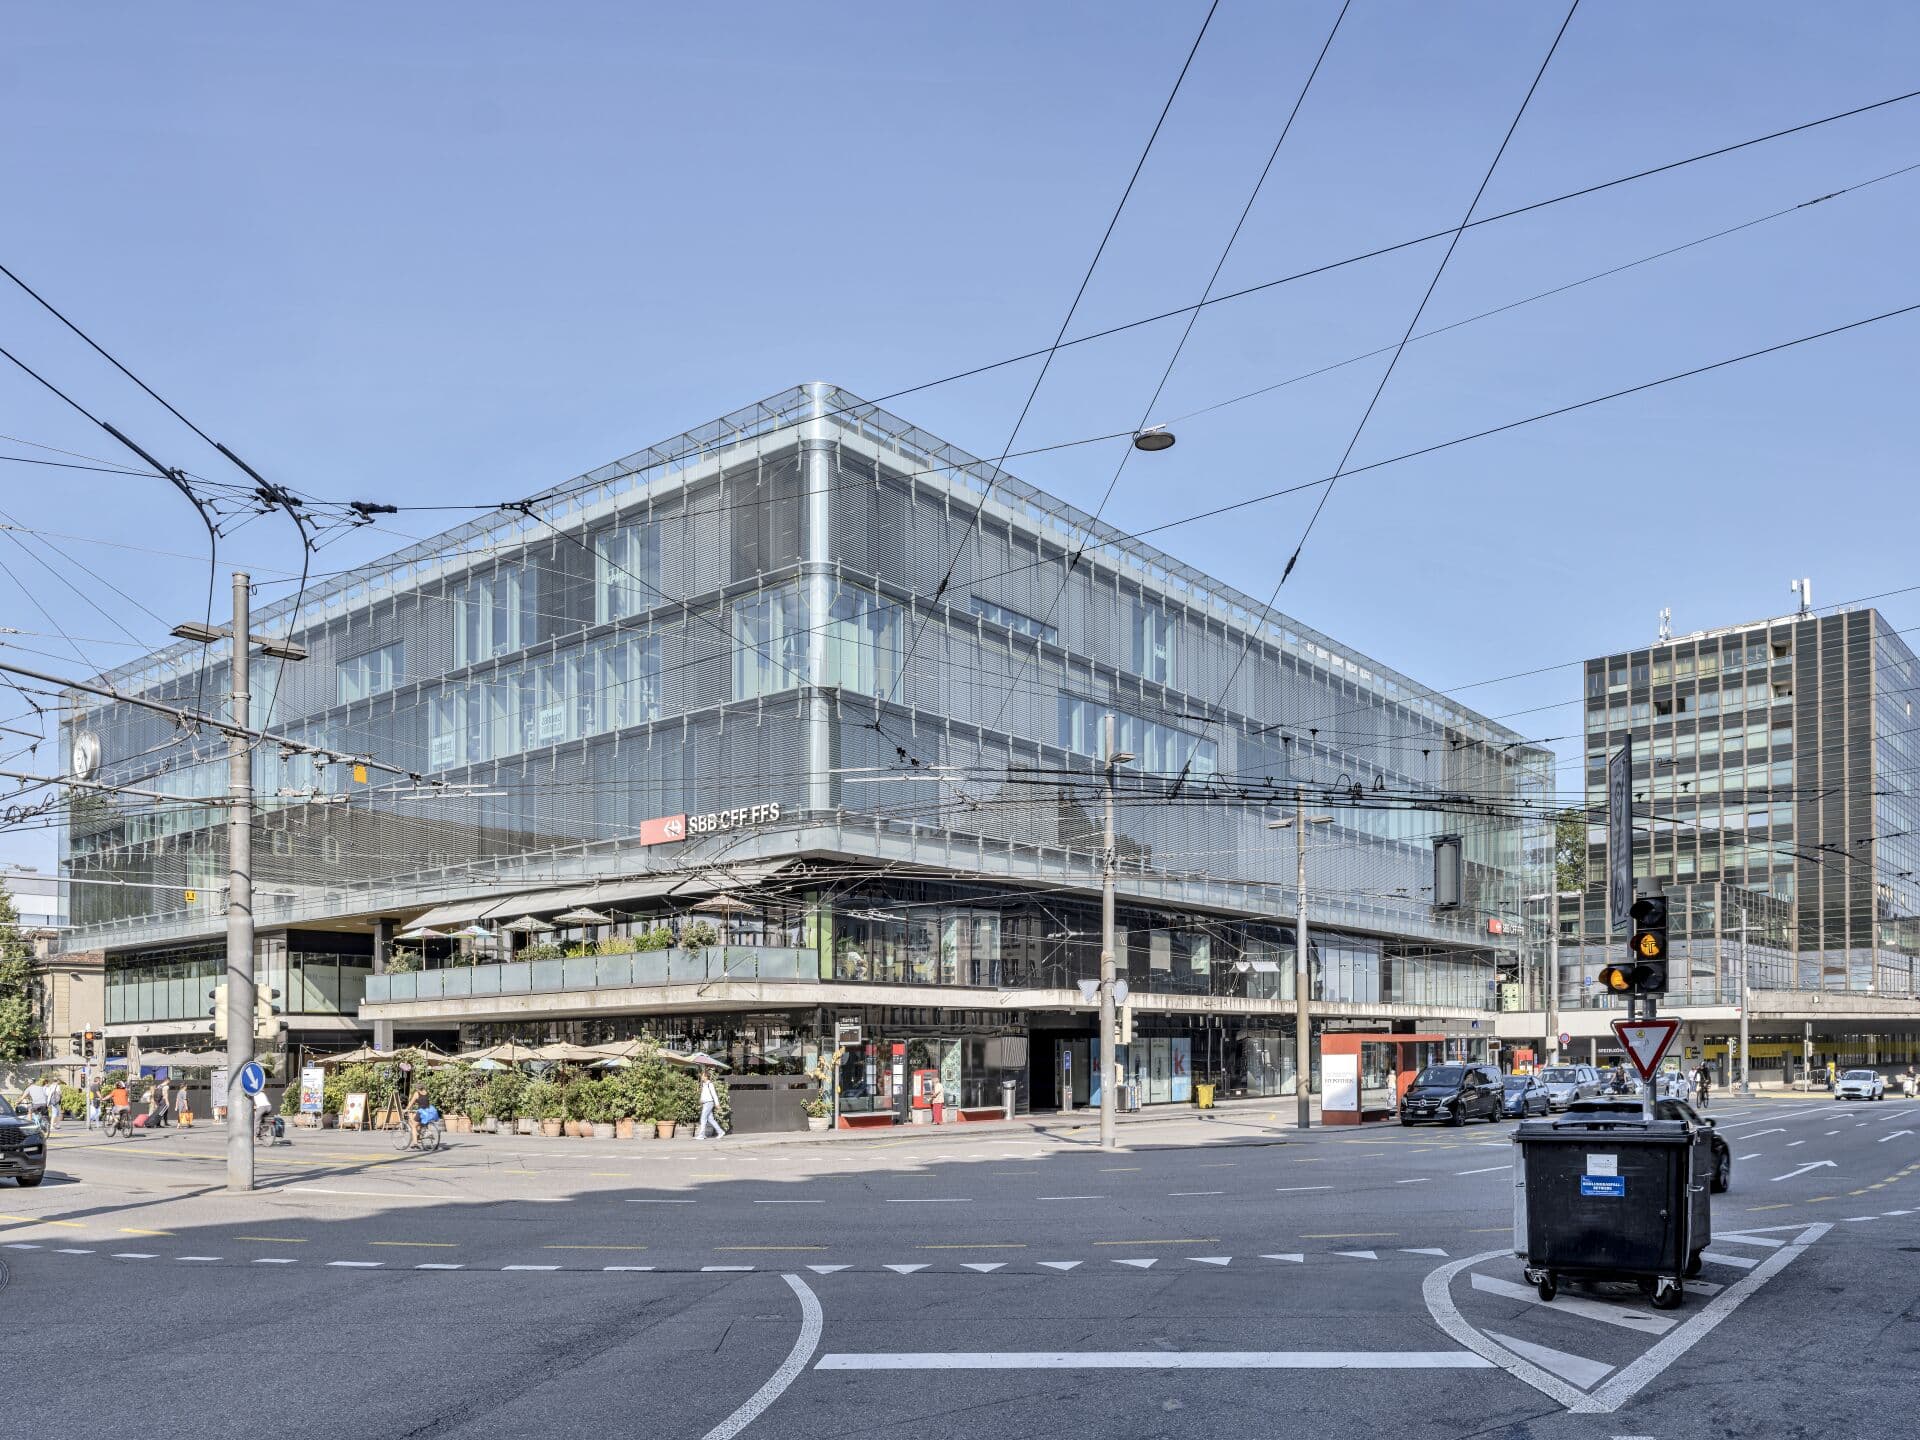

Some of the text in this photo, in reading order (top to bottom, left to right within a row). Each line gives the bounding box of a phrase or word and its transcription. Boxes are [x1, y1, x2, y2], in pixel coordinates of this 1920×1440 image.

[688, 802, 780, 835] SBB CFF FFS
